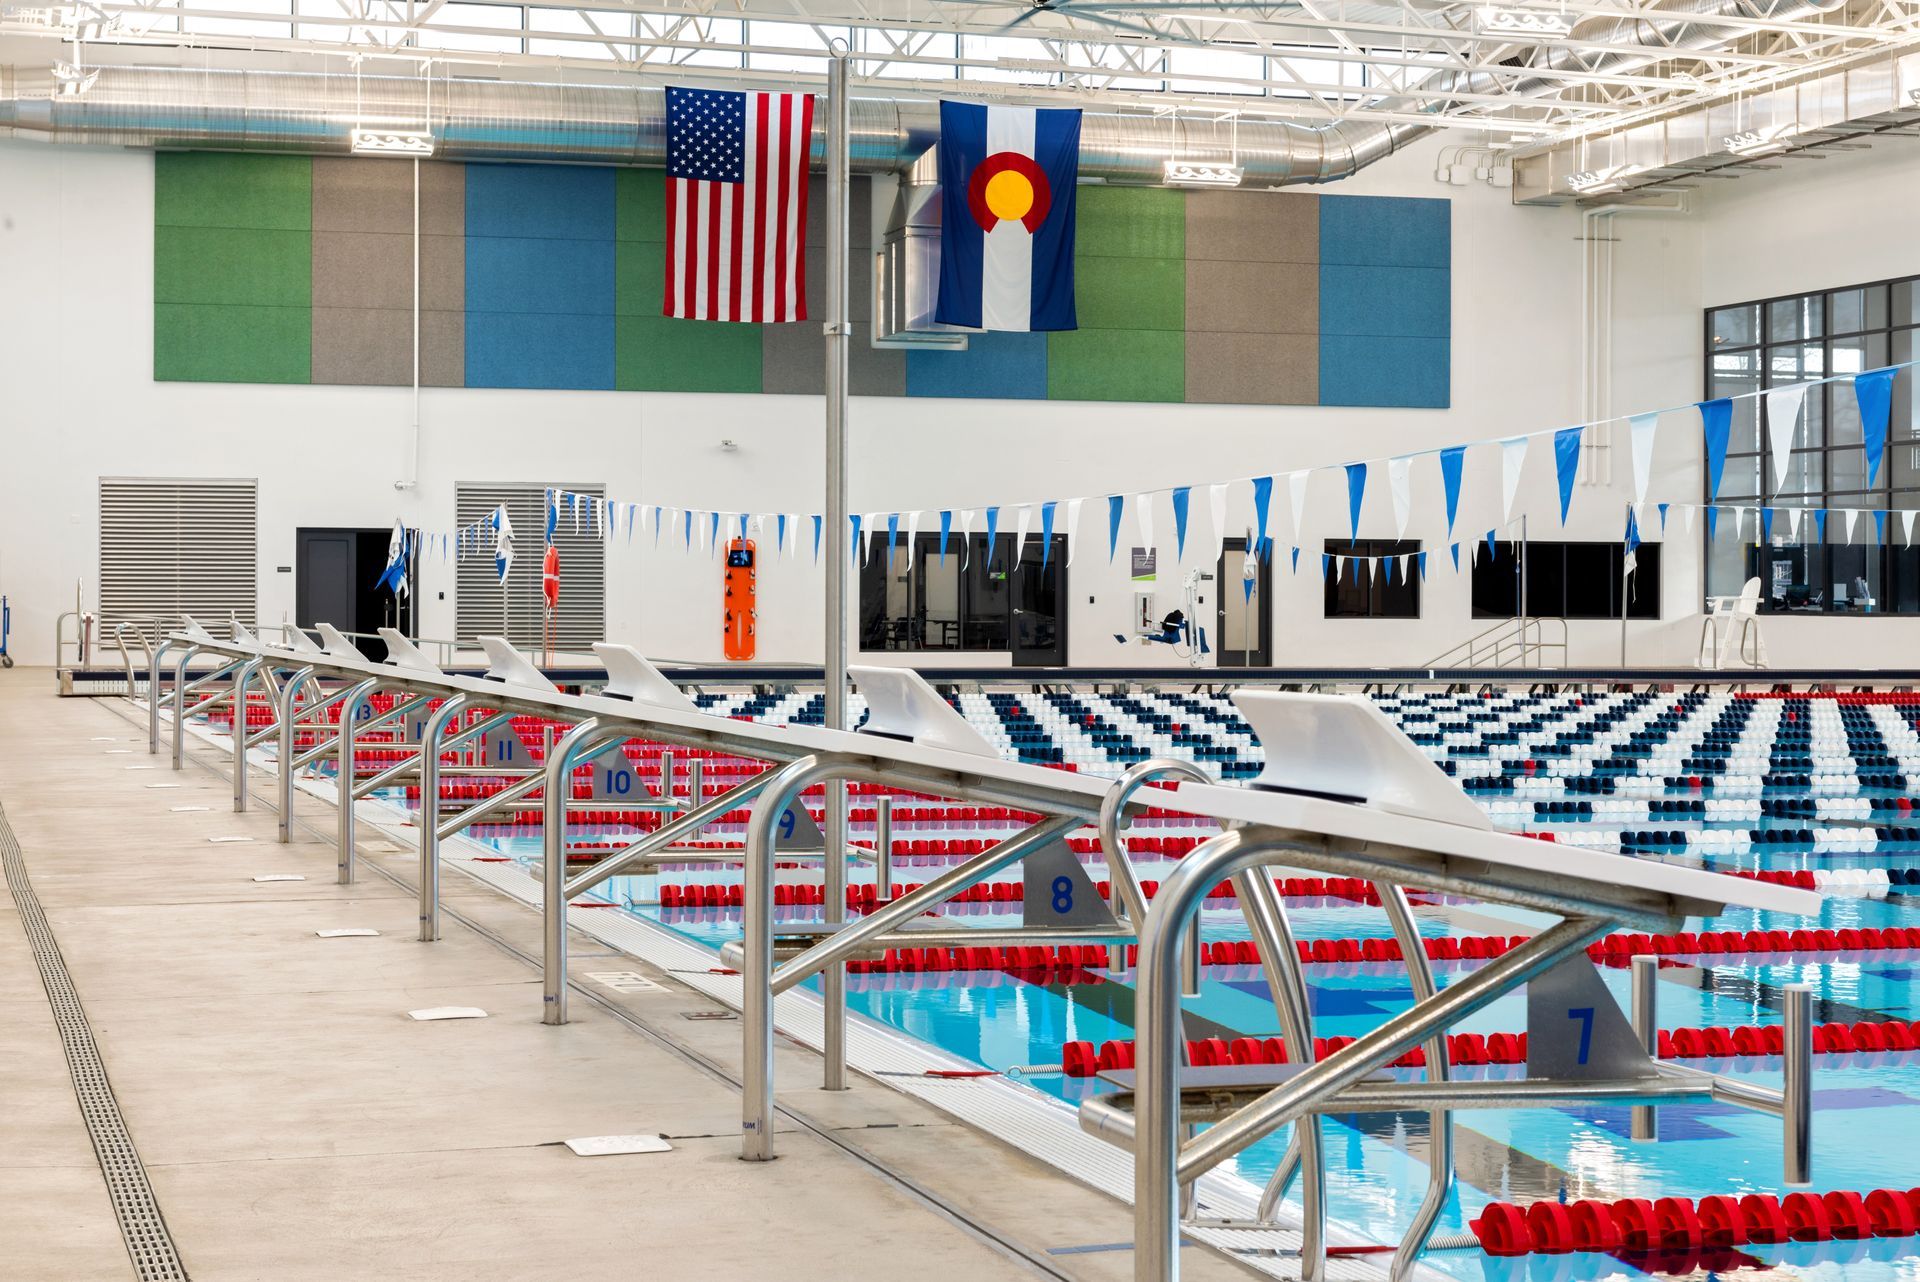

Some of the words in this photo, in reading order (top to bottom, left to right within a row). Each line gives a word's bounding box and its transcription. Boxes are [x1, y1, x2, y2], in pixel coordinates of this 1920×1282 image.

[357, 704, 371, 720] 13
[499, 740, 512, 760] 11
[607, 770, 630, 794] 10
[779, 809, 795, 839] 9
[1052, 875, 1073, 914] 8
[1568, 1007, 1594, 1065] 7
